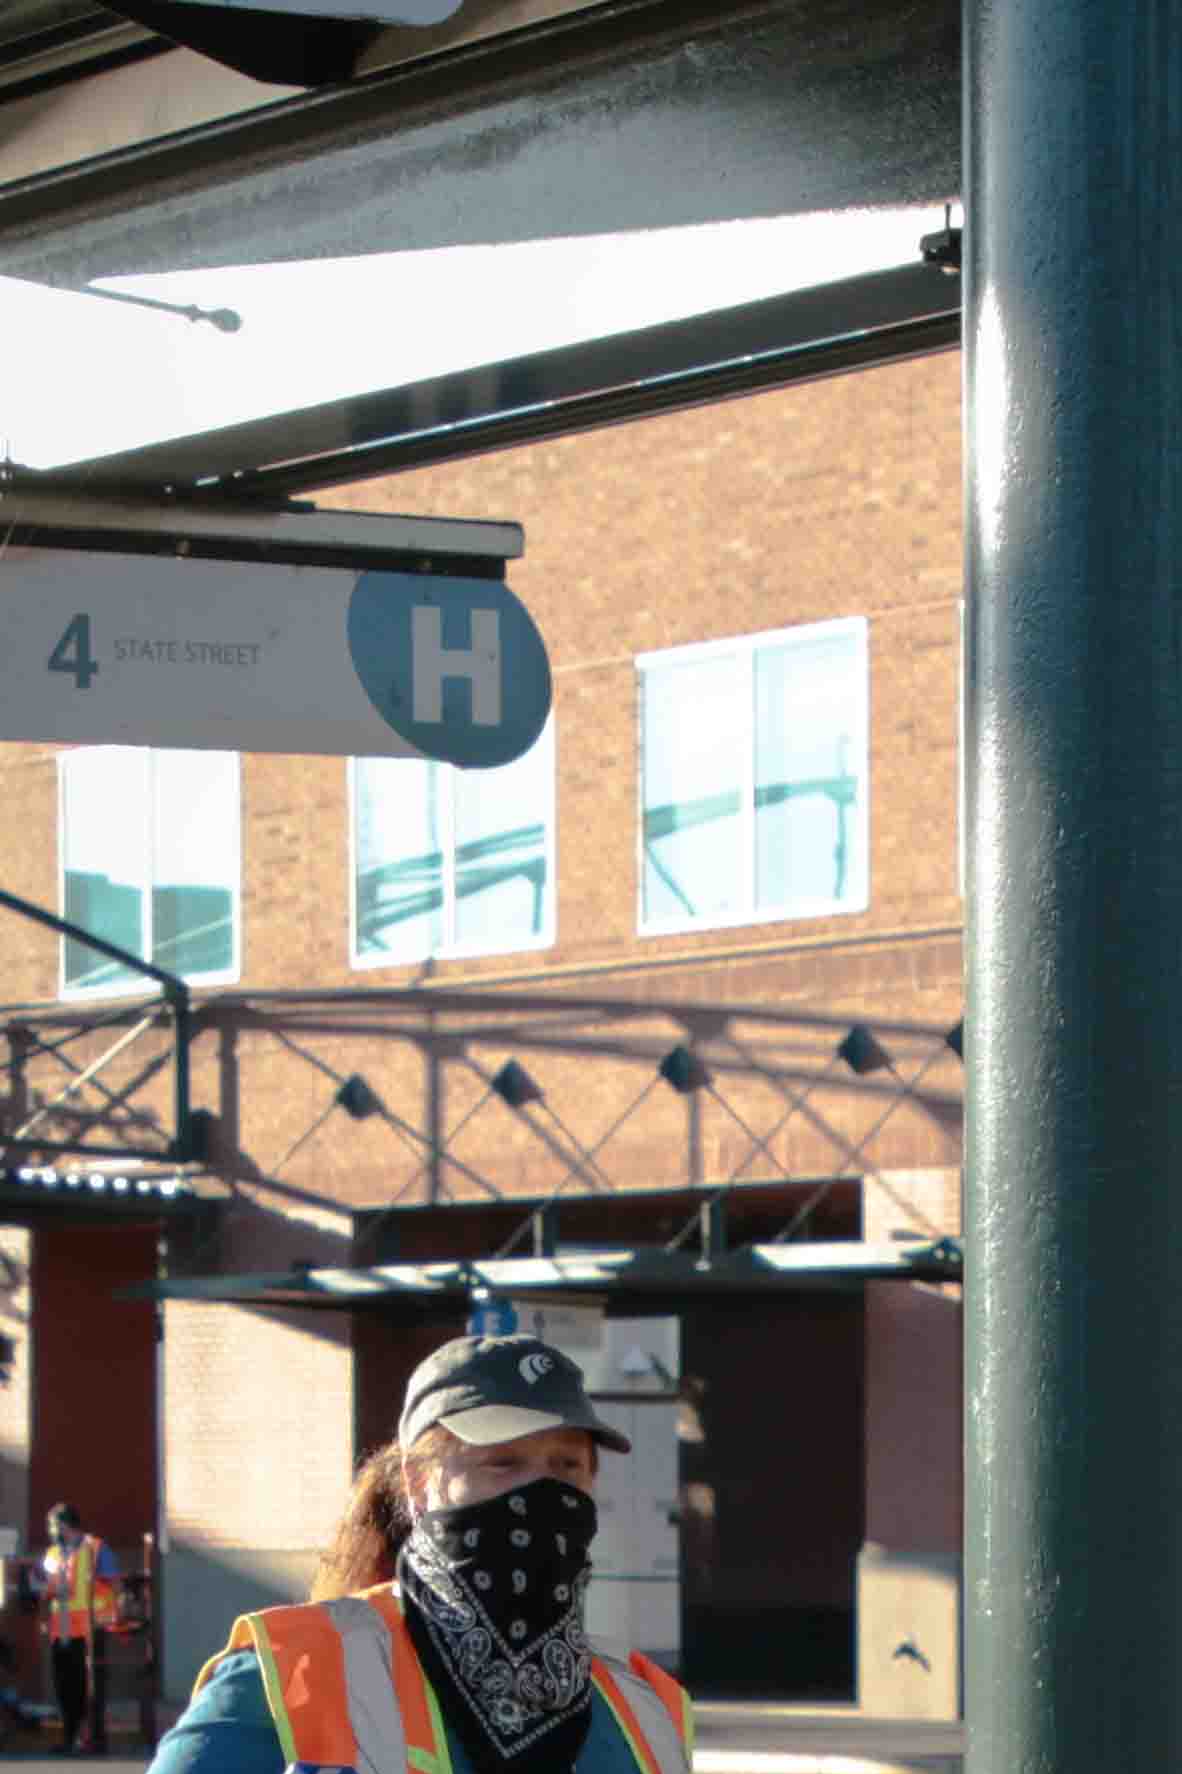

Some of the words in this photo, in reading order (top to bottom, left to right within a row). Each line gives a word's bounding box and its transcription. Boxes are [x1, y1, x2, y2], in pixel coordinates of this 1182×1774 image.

[47, 612, 99, 688] 4
[113, 639, 177, 664] STATE
[184, 640, 260, 666] STREET
[412, 605, 502, 727] H
